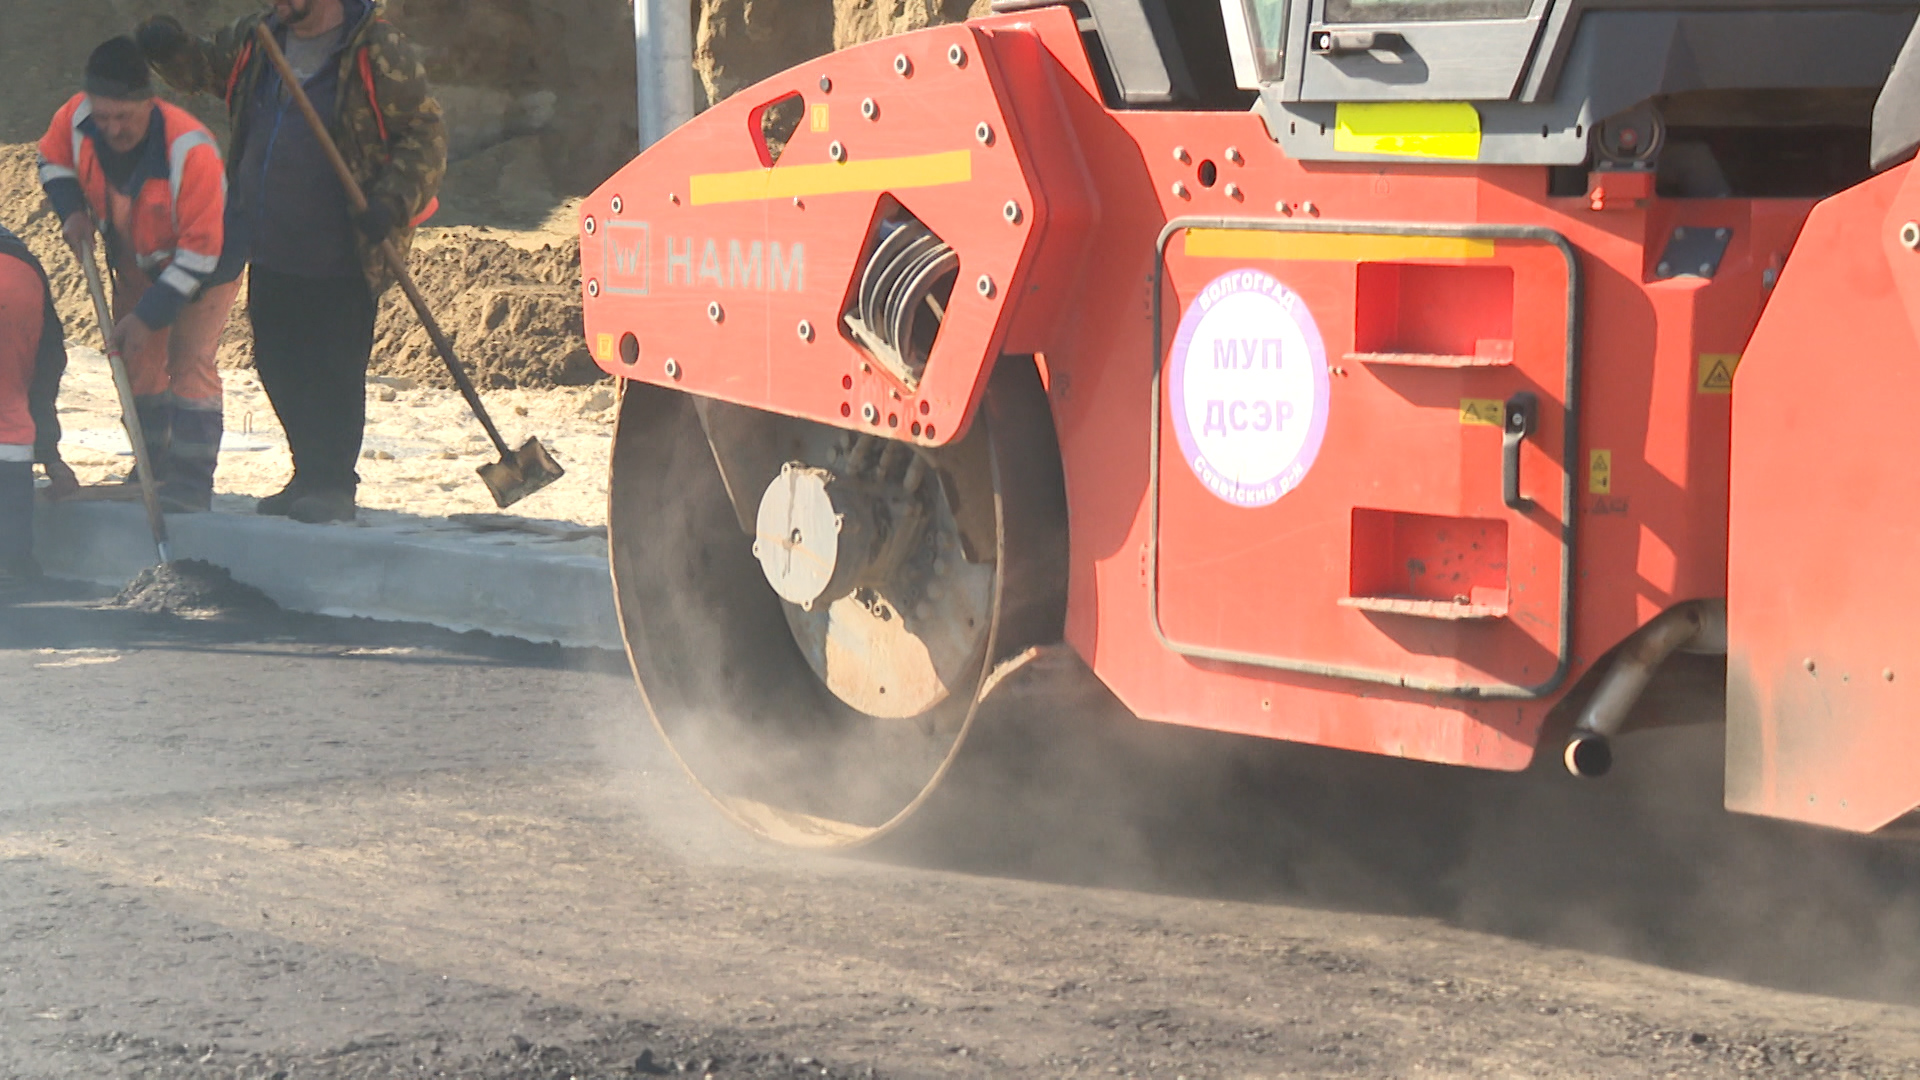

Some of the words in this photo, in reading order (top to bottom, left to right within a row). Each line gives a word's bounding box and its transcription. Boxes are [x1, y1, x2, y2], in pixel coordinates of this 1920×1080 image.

[666, 236, 805, 292] HAMM
[1198, 271, 1296, 315] ВОЛГОГРАД
[1213, 338, 1283, 370] МУП
[1203, 399, 1295, 438] ДСЭР
